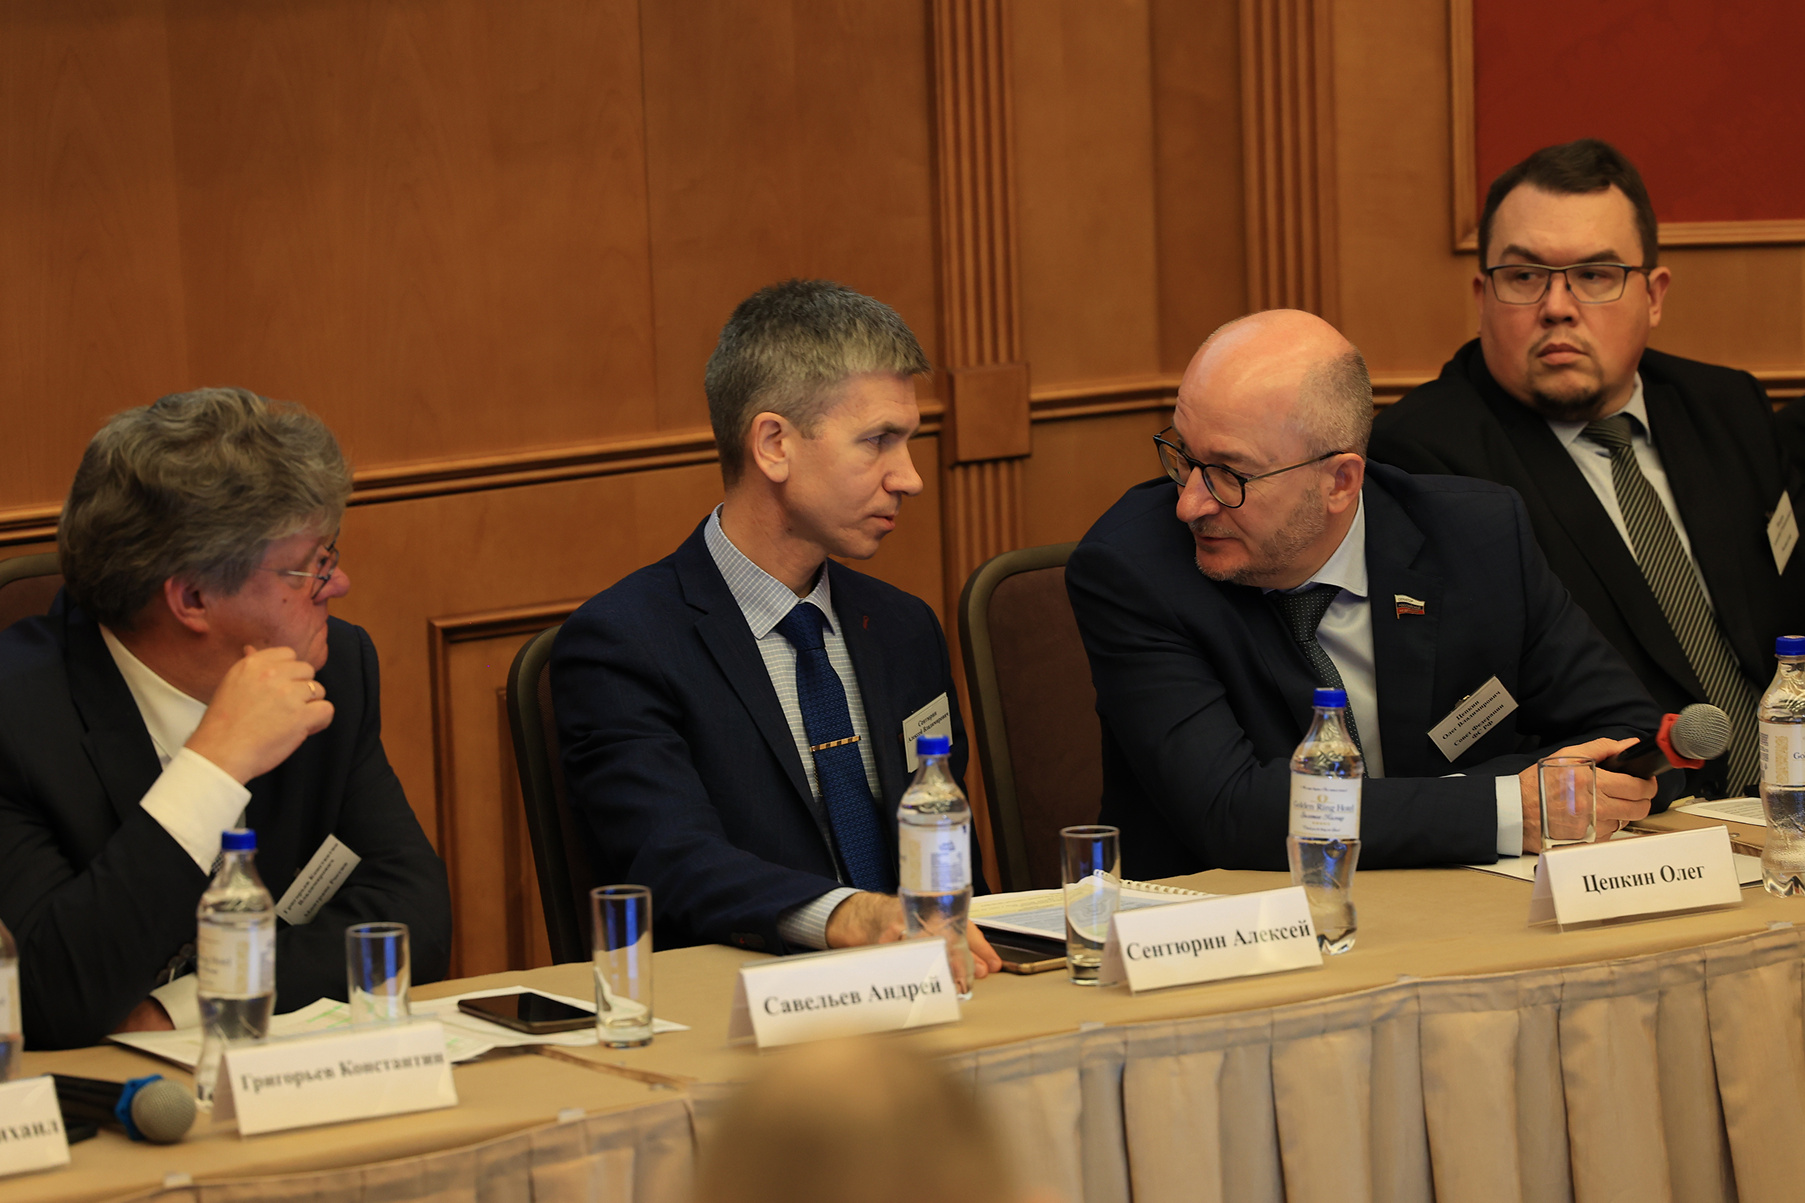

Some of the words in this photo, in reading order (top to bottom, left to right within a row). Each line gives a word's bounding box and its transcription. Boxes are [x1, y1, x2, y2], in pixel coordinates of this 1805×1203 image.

[1793, 751, 1805, 760] Go
[1582, 872, 1656, 895] Цепкин
[1660, 864, 1705, 883] Олег
[1126, 933, 1227, 961] Сентюрин
[1233, 920, 1311, 947] Алексей
[764, 990, 862, 1017] Савельев
[868, 975, 942, 1003] Андрей
[240, 1066, 335, 1094] Григорьев
[338, 1052, 444, 1078] Константин
